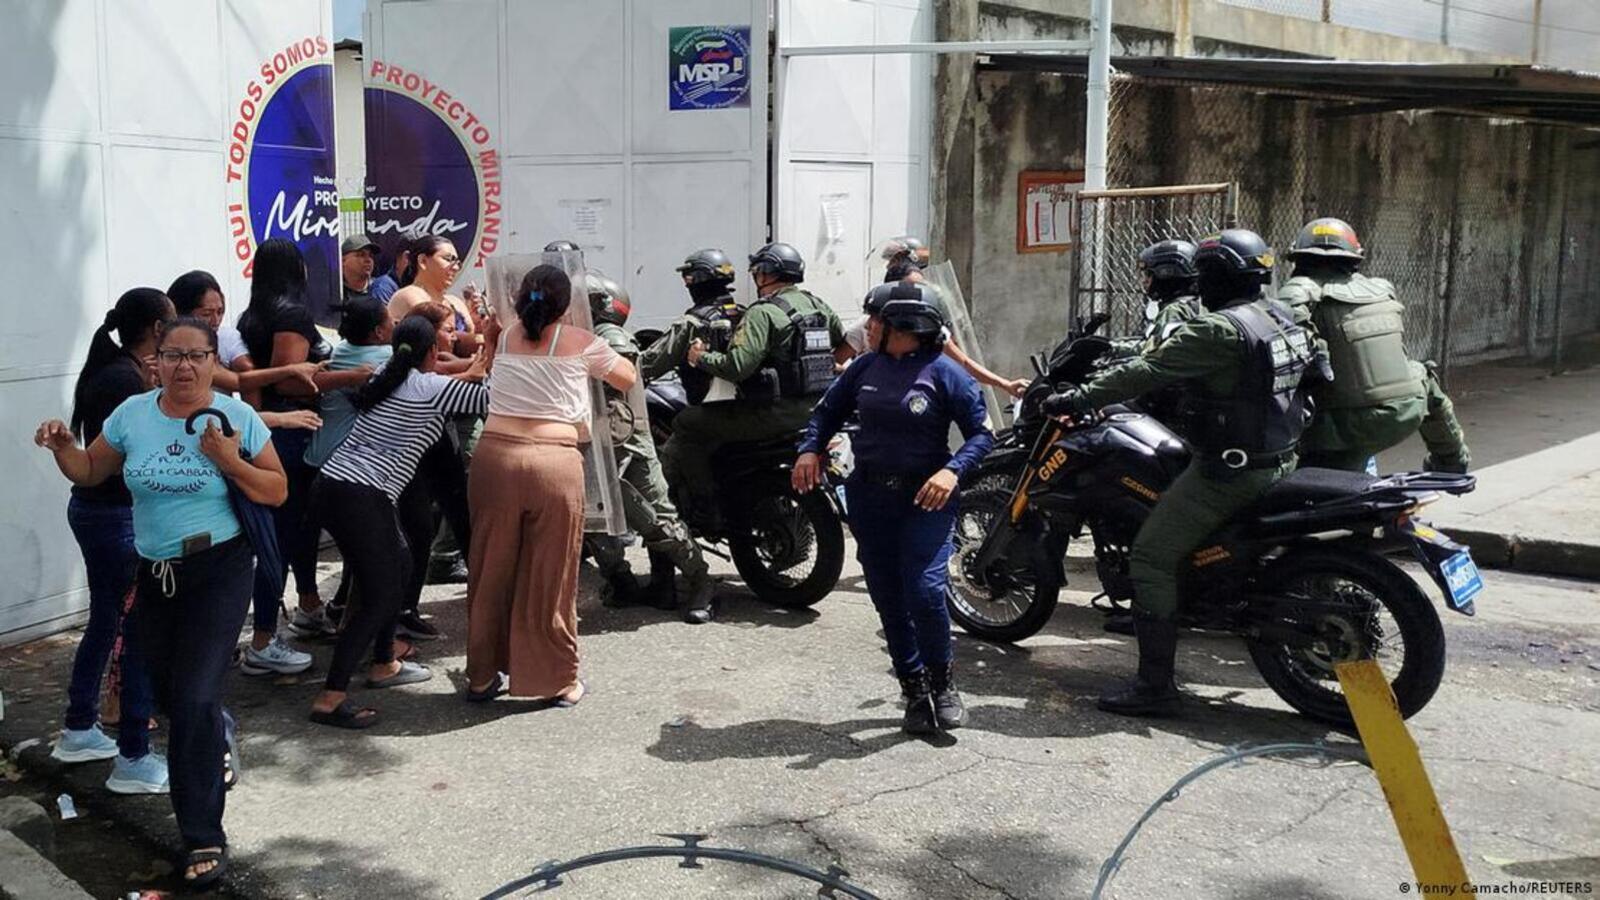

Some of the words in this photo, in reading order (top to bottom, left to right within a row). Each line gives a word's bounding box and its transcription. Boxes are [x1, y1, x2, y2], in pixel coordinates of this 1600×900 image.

[261, 35, 328, 85] SOMOS
[679, 63, 730, 83] MSP
[227, 81, 262, 183] TODOS
[371, 60, 490, 145] PROYECTO
[474, 149, 501, 268] MIRANDA
[229, 204, 254, 278] AQUI
[166, 467, 221, 478] GABBAN
[1039, 448, 1067, 481] GNB
